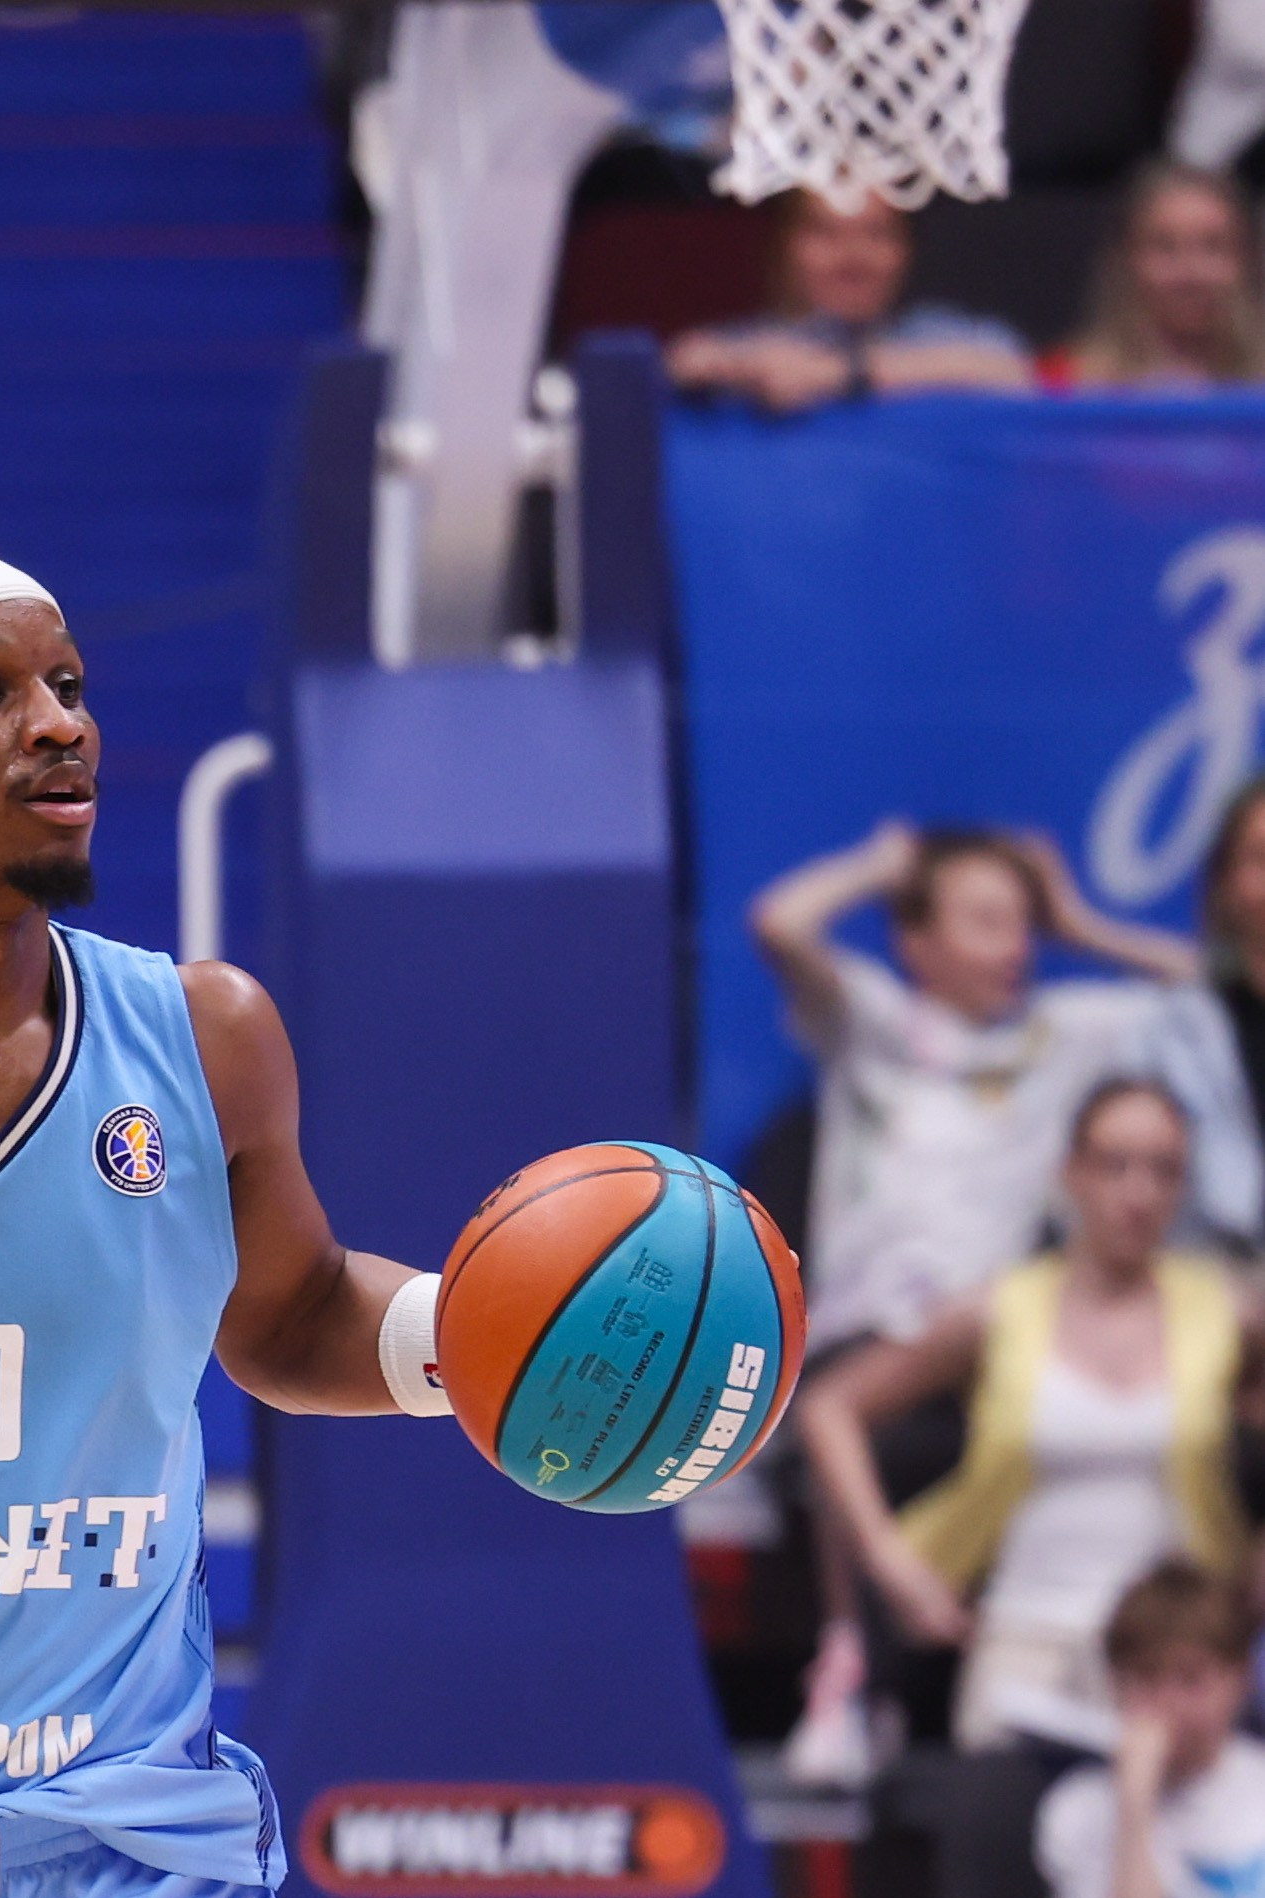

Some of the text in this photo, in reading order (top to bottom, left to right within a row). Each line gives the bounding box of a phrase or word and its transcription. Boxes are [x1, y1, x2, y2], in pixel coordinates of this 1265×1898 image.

[578, 1330, 665, 1472] SECOND LIFE OF PLASTIC
[647, 1343, 766, 1502] SIBUR
[335, 1806, 627, 1878] WINLINE
